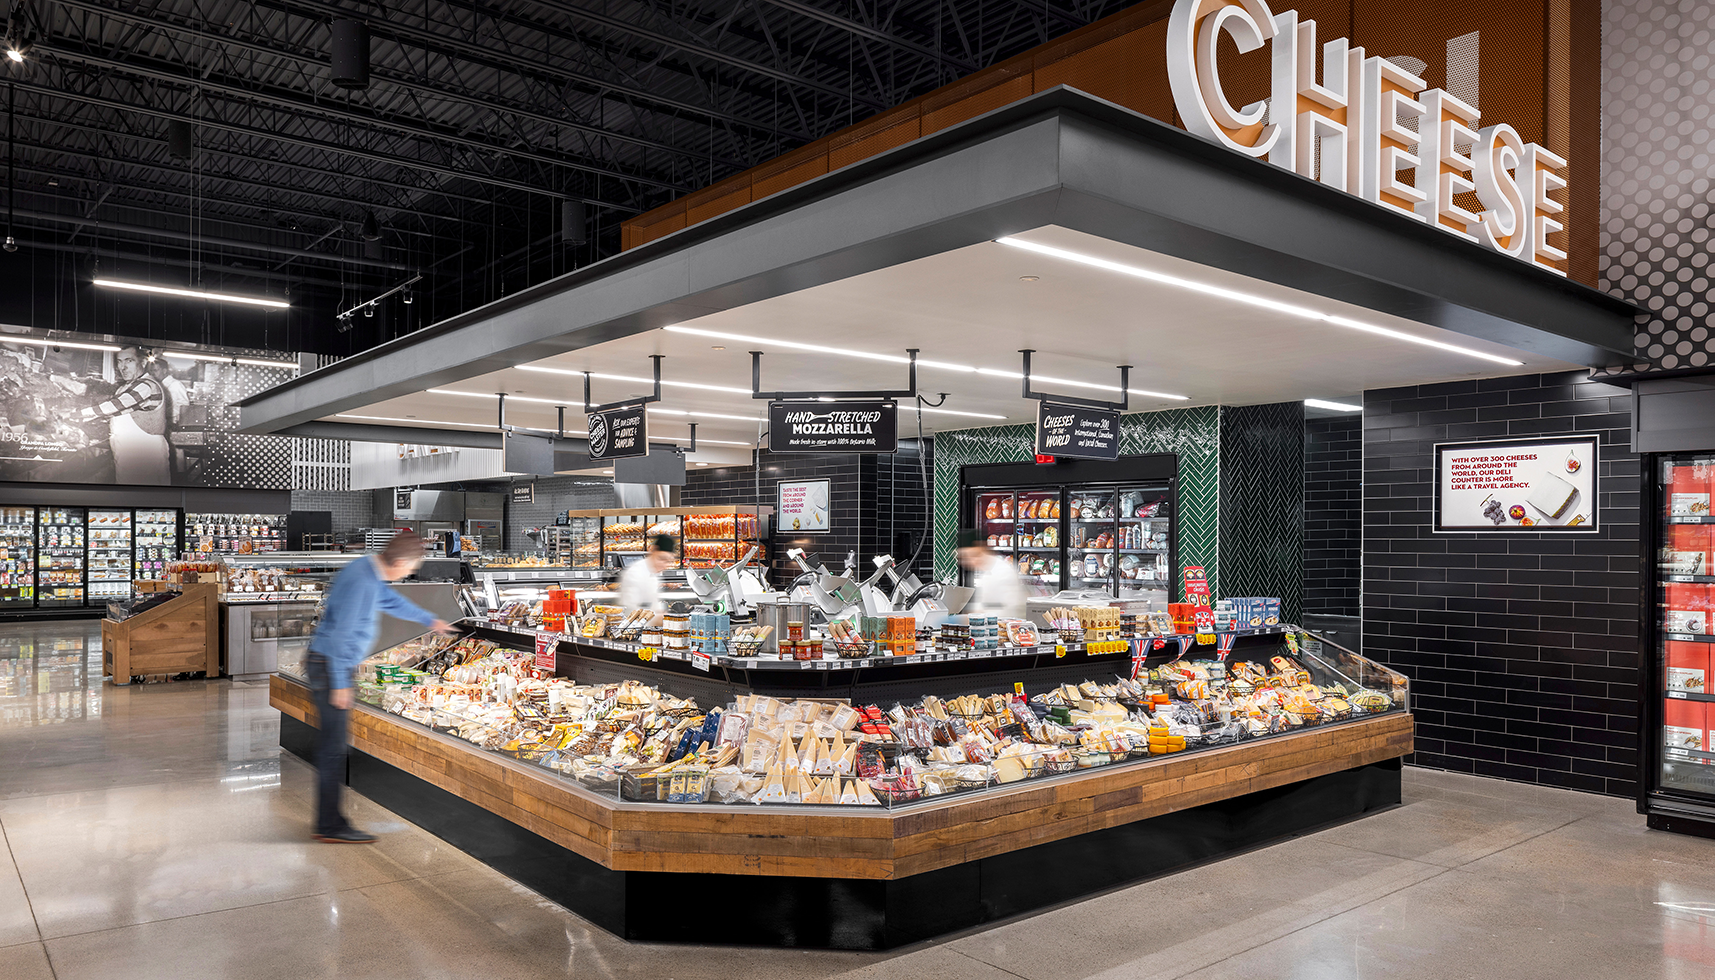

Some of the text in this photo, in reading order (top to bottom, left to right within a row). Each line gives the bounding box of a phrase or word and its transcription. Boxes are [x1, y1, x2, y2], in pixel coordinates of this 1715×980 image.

[1166, 0, 1568, 278] CHEESE
[785, 411, 881, 423] HAND STRETCHED
[1043, 414, 1075, 428] CHEESES
[792, 424, 872, 434] MOZZARELLA
[2, 432, 28, 442] 1956
[1046, 434, 1070, 448] WORLD
